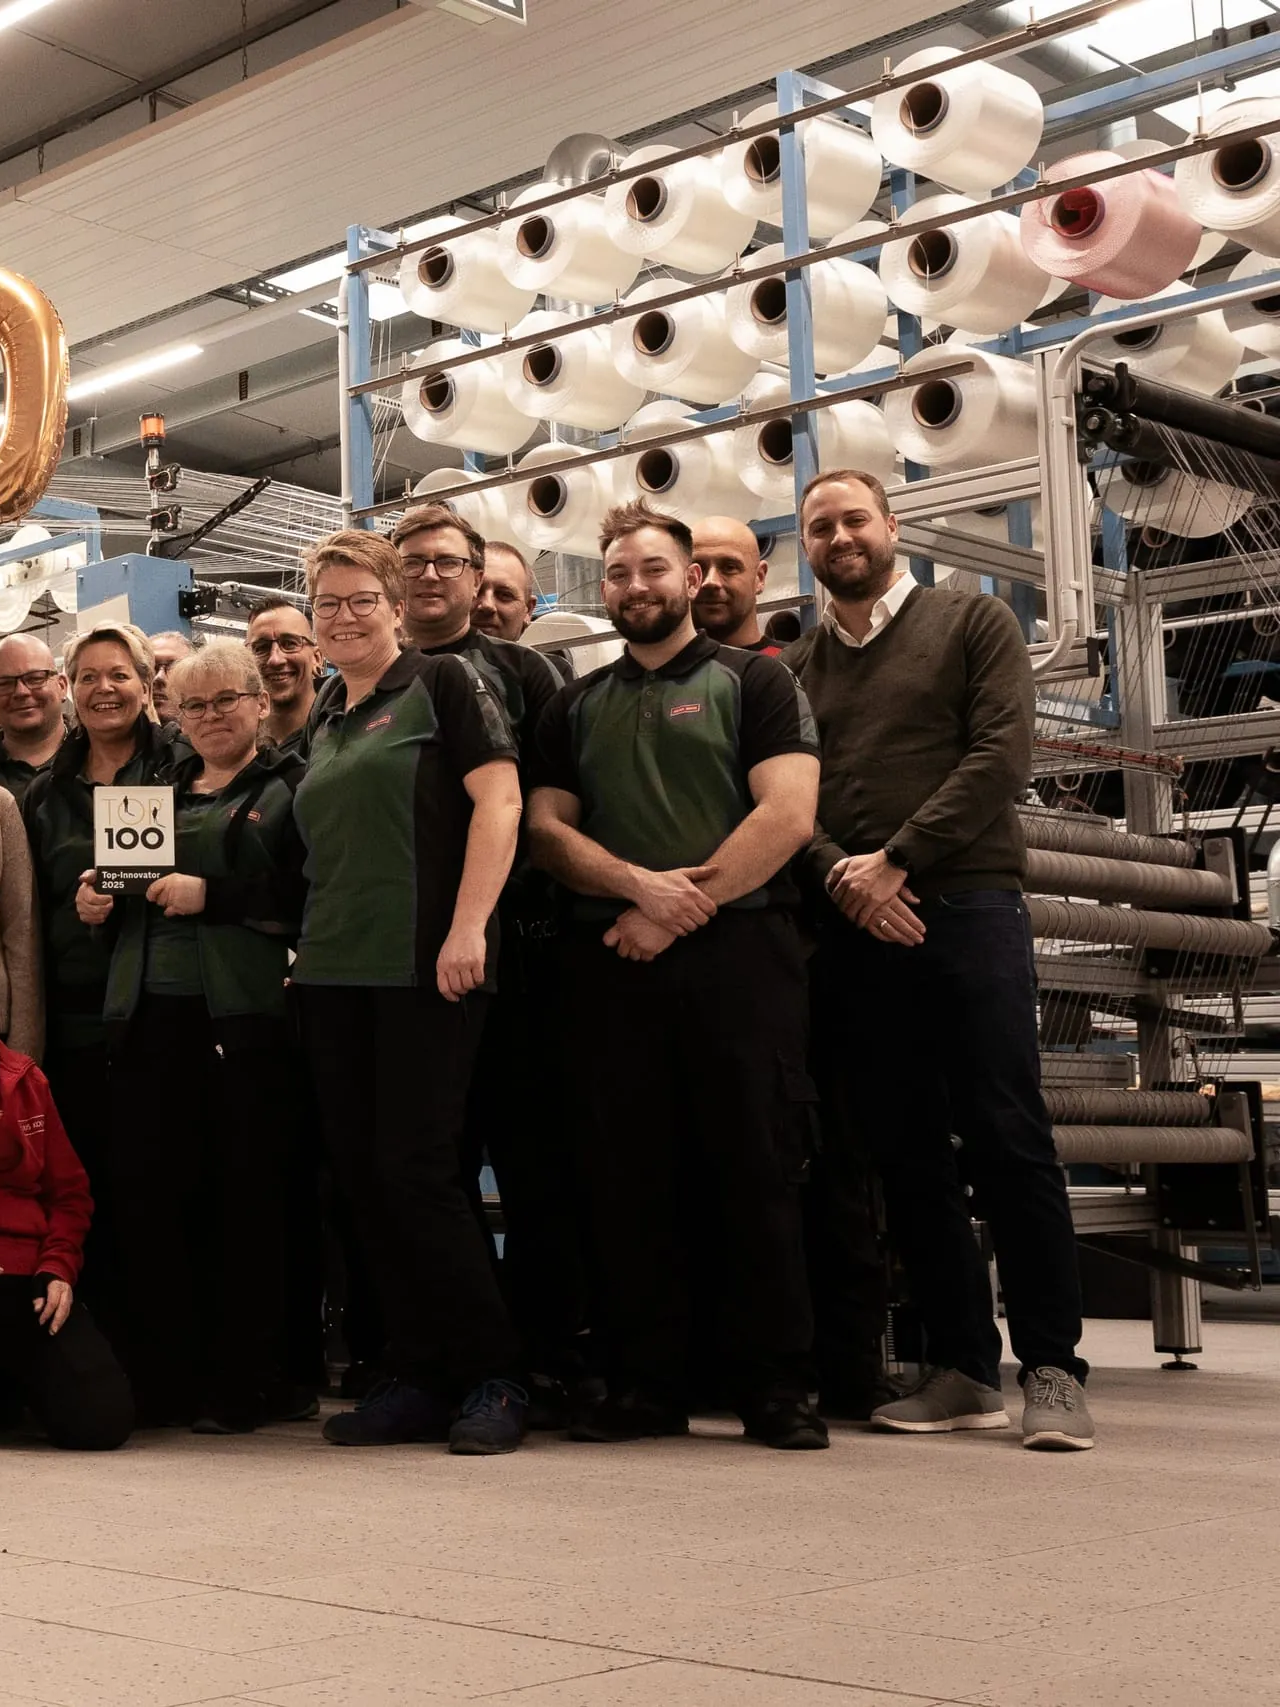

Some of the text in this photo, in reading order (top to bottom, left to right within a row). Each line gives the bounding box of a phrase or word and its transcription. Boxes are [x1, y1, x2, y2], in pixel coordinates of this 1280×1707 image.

[104, 827, 165, 850] 100
[101, 871, 160, 880] Top-Innovator
[101, 881, 125, 889] 2025
